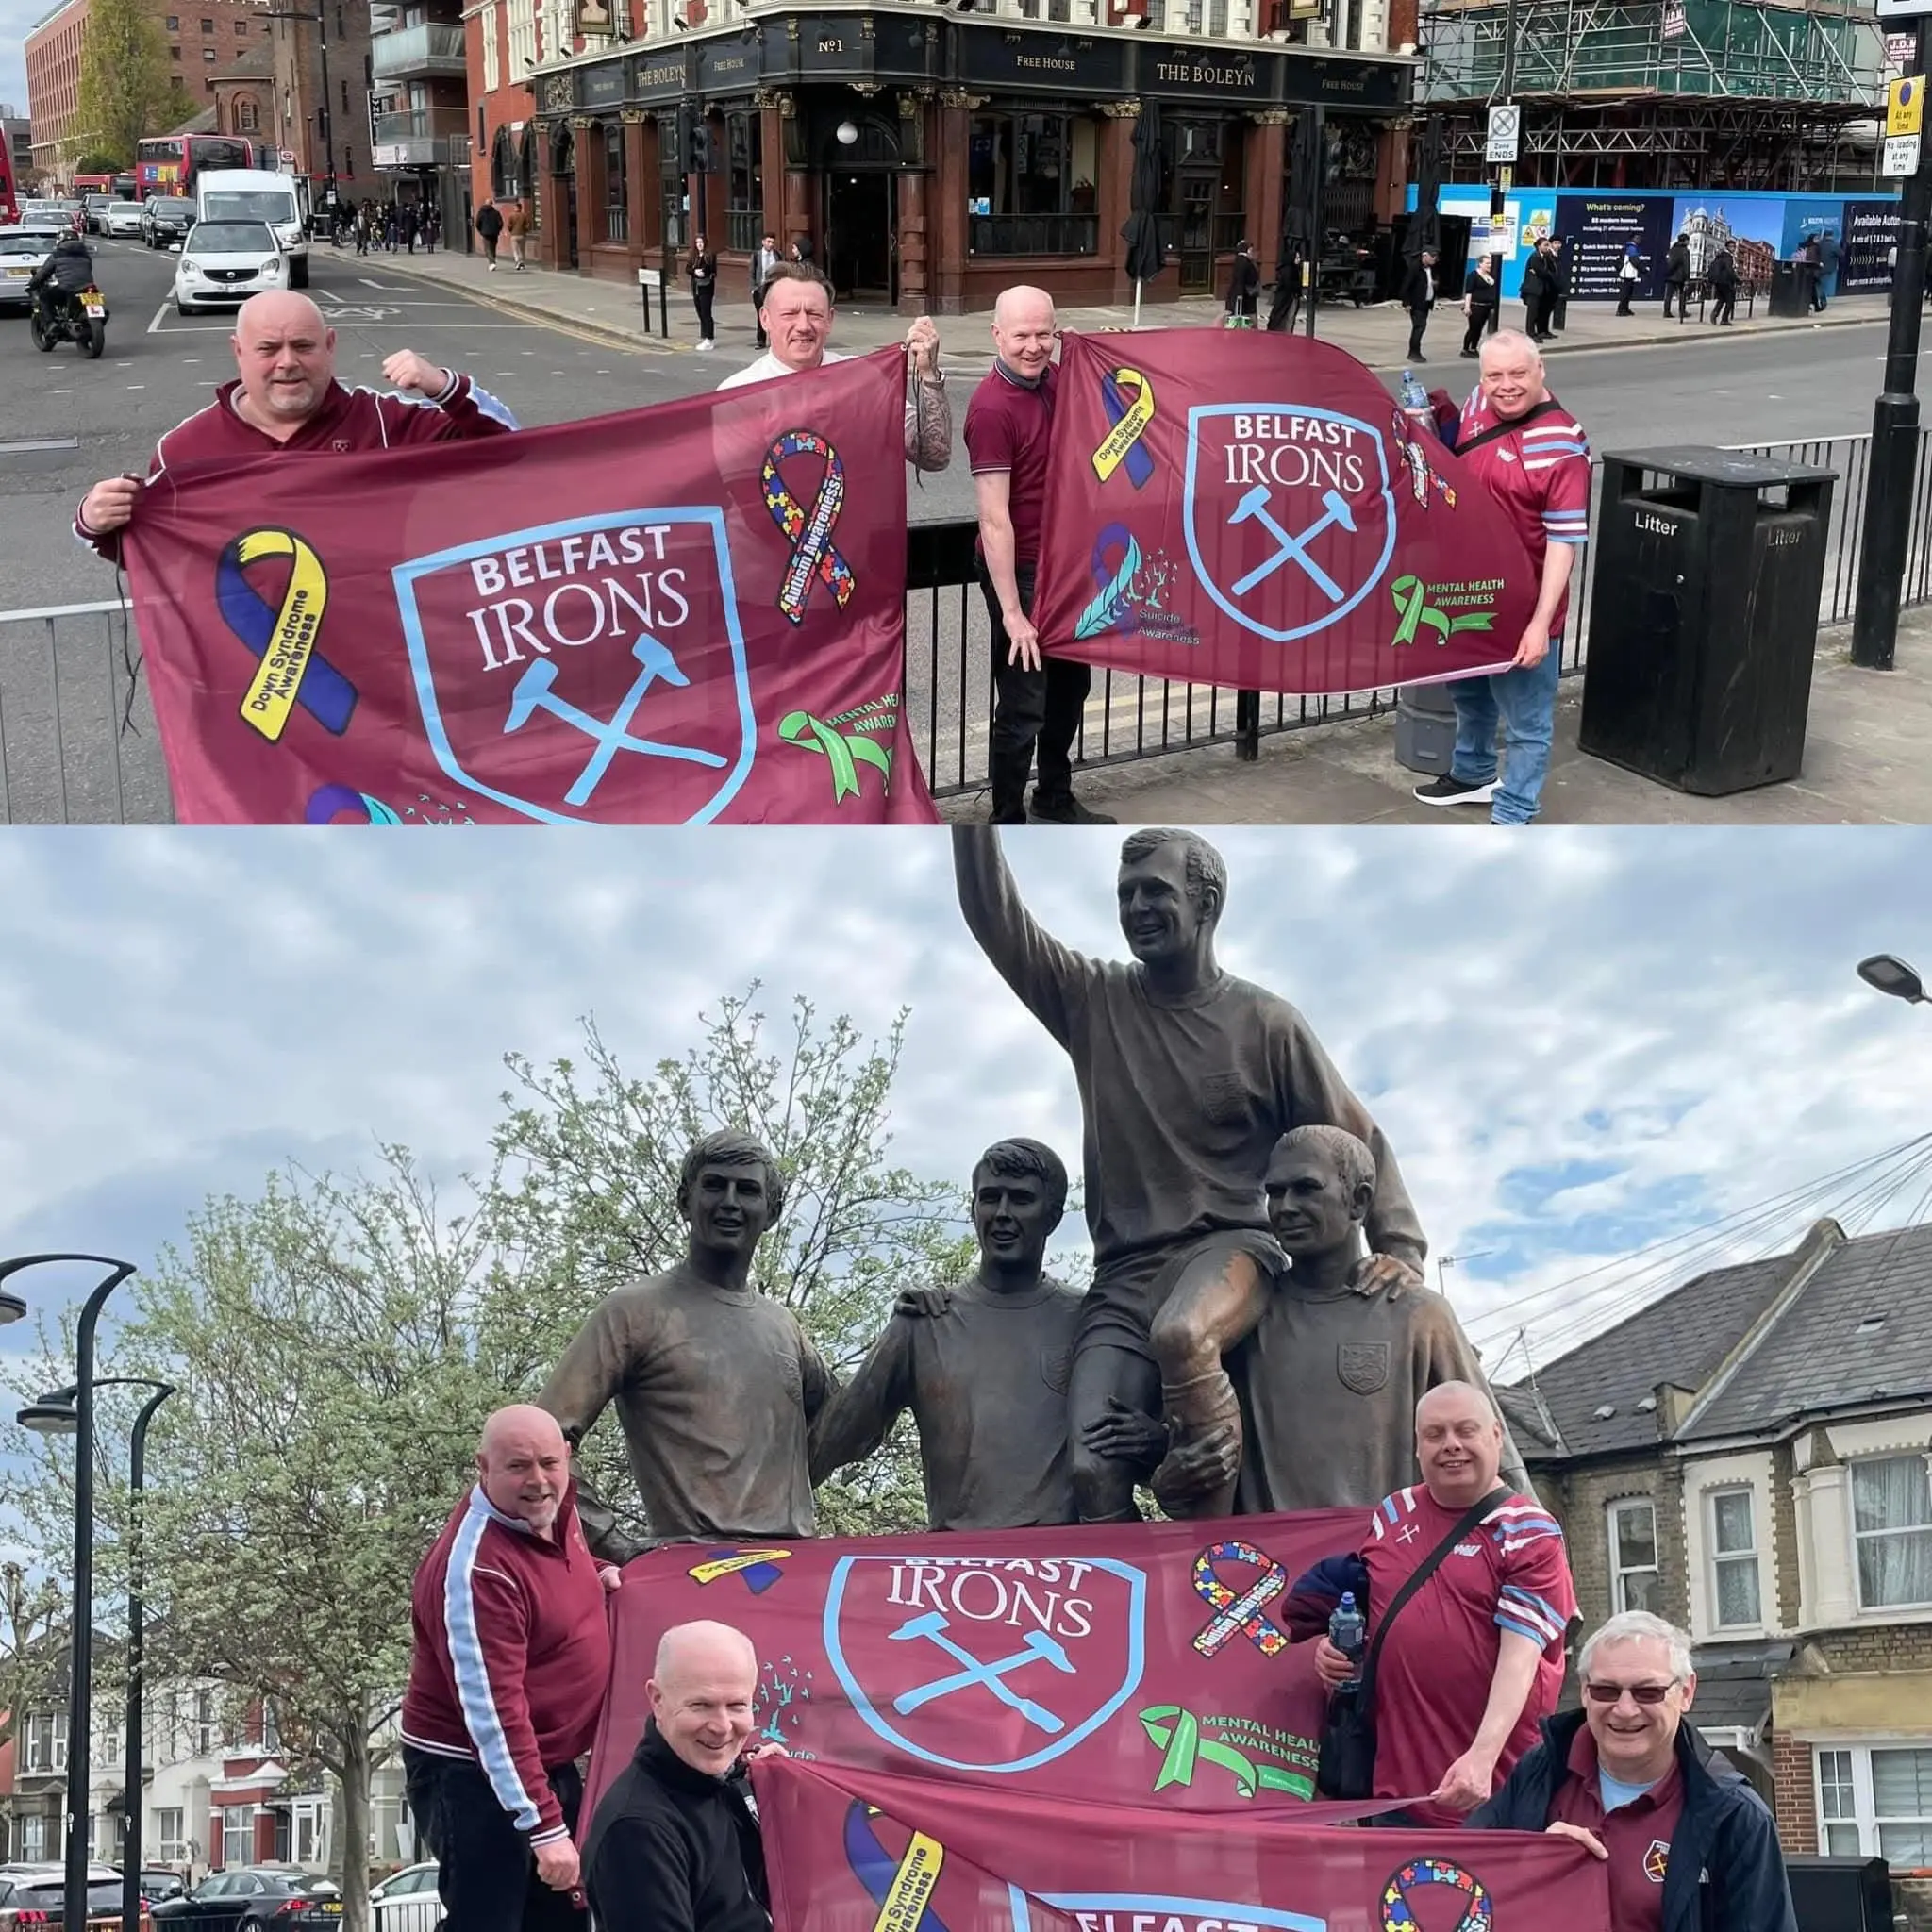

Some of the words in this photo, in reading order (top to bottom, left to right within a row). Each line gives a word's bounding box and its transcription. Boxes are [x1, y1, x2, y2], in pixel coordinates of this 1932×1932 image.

[637, 70, 652, 88] THE
[652, 65, 686, 86] BOLEYN
[1017, 56, 1041, 67] FREE
[1042, 58, 1076, 71] HOUSE
[1157, 63, 1190, 82] THE
[1193, 67, 1255, 86] BOLEYN
[1586, 203, 1612, 212] What's
[1613, 203, 1645, 213] coming?
[1234, 415, 1356, 448] BELFAST
[1224, 444, 1364, 492] IRONS
[1635, 512, 1678, 536] Litter
[1768, 526, 1802, 546] Litter
[471, 525, 671, 596] BELFAST
[784, 555, 813, 607] Autism
[1426, 582, 1466, 593] MENTAL
[1468, 578, 1505, 591] HEALTH
[1434, 593, 1494, 607] AWARENESS
[466, 568, 689, 672] IRONS
[1139, 608, 1180, 623] Suicide
[1138, 626, 1200, 645] Awareness
[251, 672, 280, 711] Down
[269, 590, 308, 669] Syndrome
[273, 613, 316, 700] Awareness
[826, 701, 884, 726] MENTAL
[886, 1565, 1093, 1638] IRONS
[1202, 1716, 1271, 1738] MENTAL
[1275, 1729, 1321, 1753] HEAL
[1219, 1731, 1320, 1772] AWARENESS
[888, 1848, 927, 1919] Syndrome
